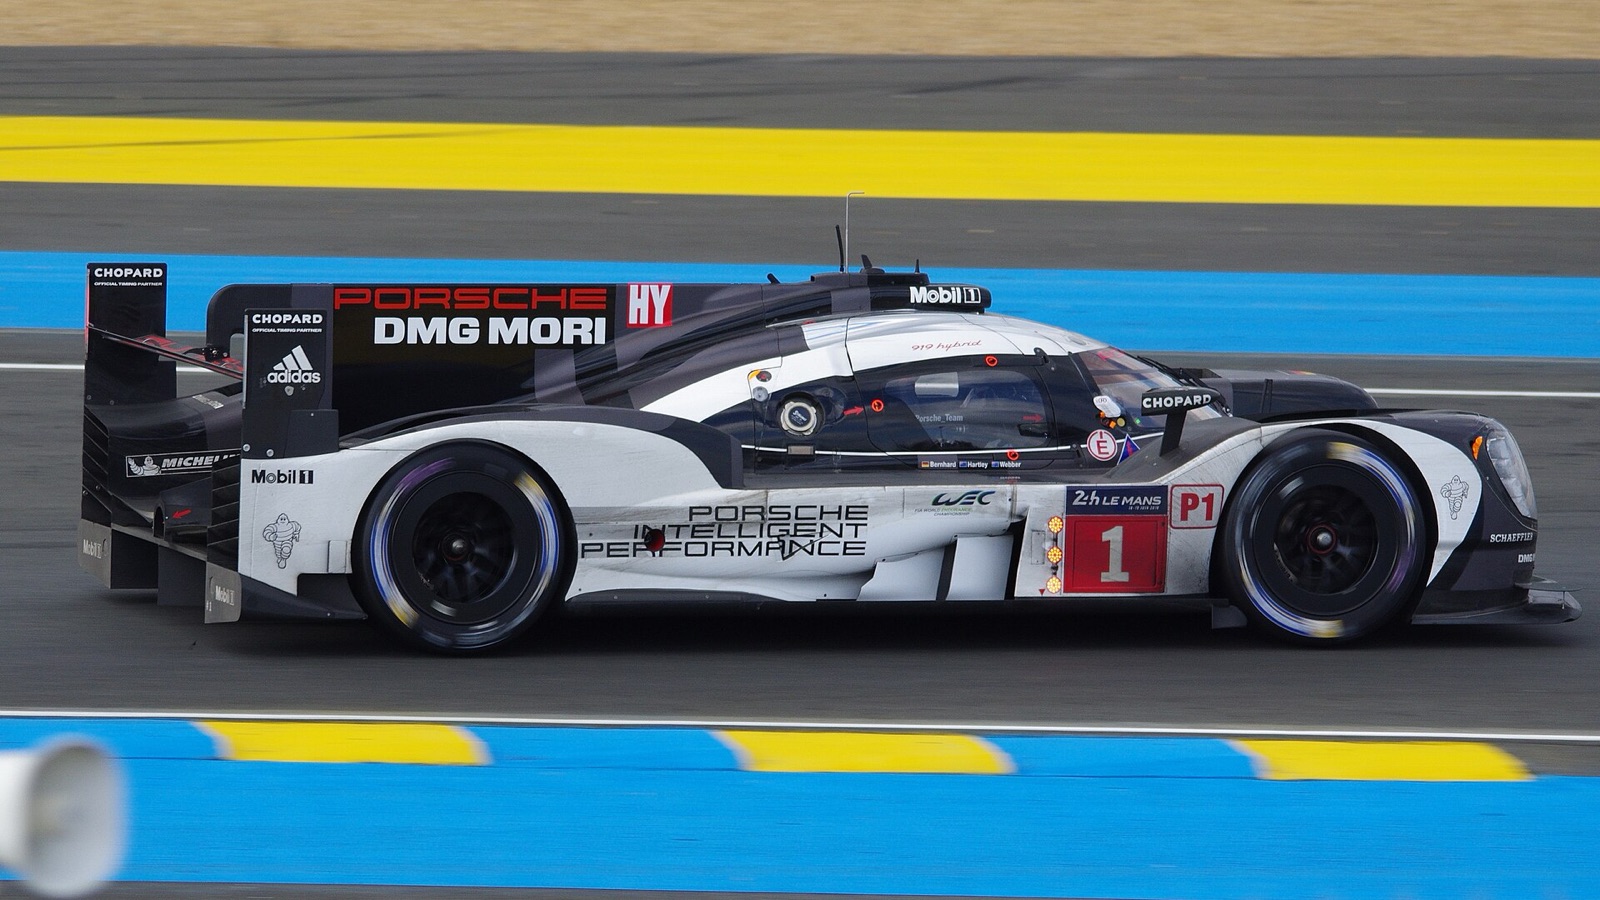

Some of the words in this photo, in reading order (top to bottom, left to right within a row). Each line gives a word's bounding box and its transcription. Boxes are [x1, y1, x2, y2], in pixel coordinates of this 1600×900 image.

[94, 268, 163, 278] CHOPARD
[334, 288, 607, 310] PORSCHE
[909, 286, 961, 303] Mobil
[629, 284, 671, 324] HY
[252, 314, 323, 324] CHOPARD
[373, 317, 480, 345] DMG
[488, 317, 606, 345] MORI
[911, 343, 934, 351] 919
[936, 339, 982, 352] hybrid
[267, 369, 321, 383] adidas
[1142, 394, 1211, 409] CHOPARD
[967, 461, 988, 469] Hartley
[252, 469, 296, 484] Mobil
[931, 490, 996, 506] WEC
[1102, 496, 1120, 506] LE
[1121, 496, 1162, 506] MANS
[688, 505, 869, 522] PORSCHE
[1180, 492, 1214, 522] P1
[1490, 532, 1533, 543] SCHAEFFLER
[581, 540, 866, 559] PERFORMANCE
[1100, 525, 1130, 583] 1
